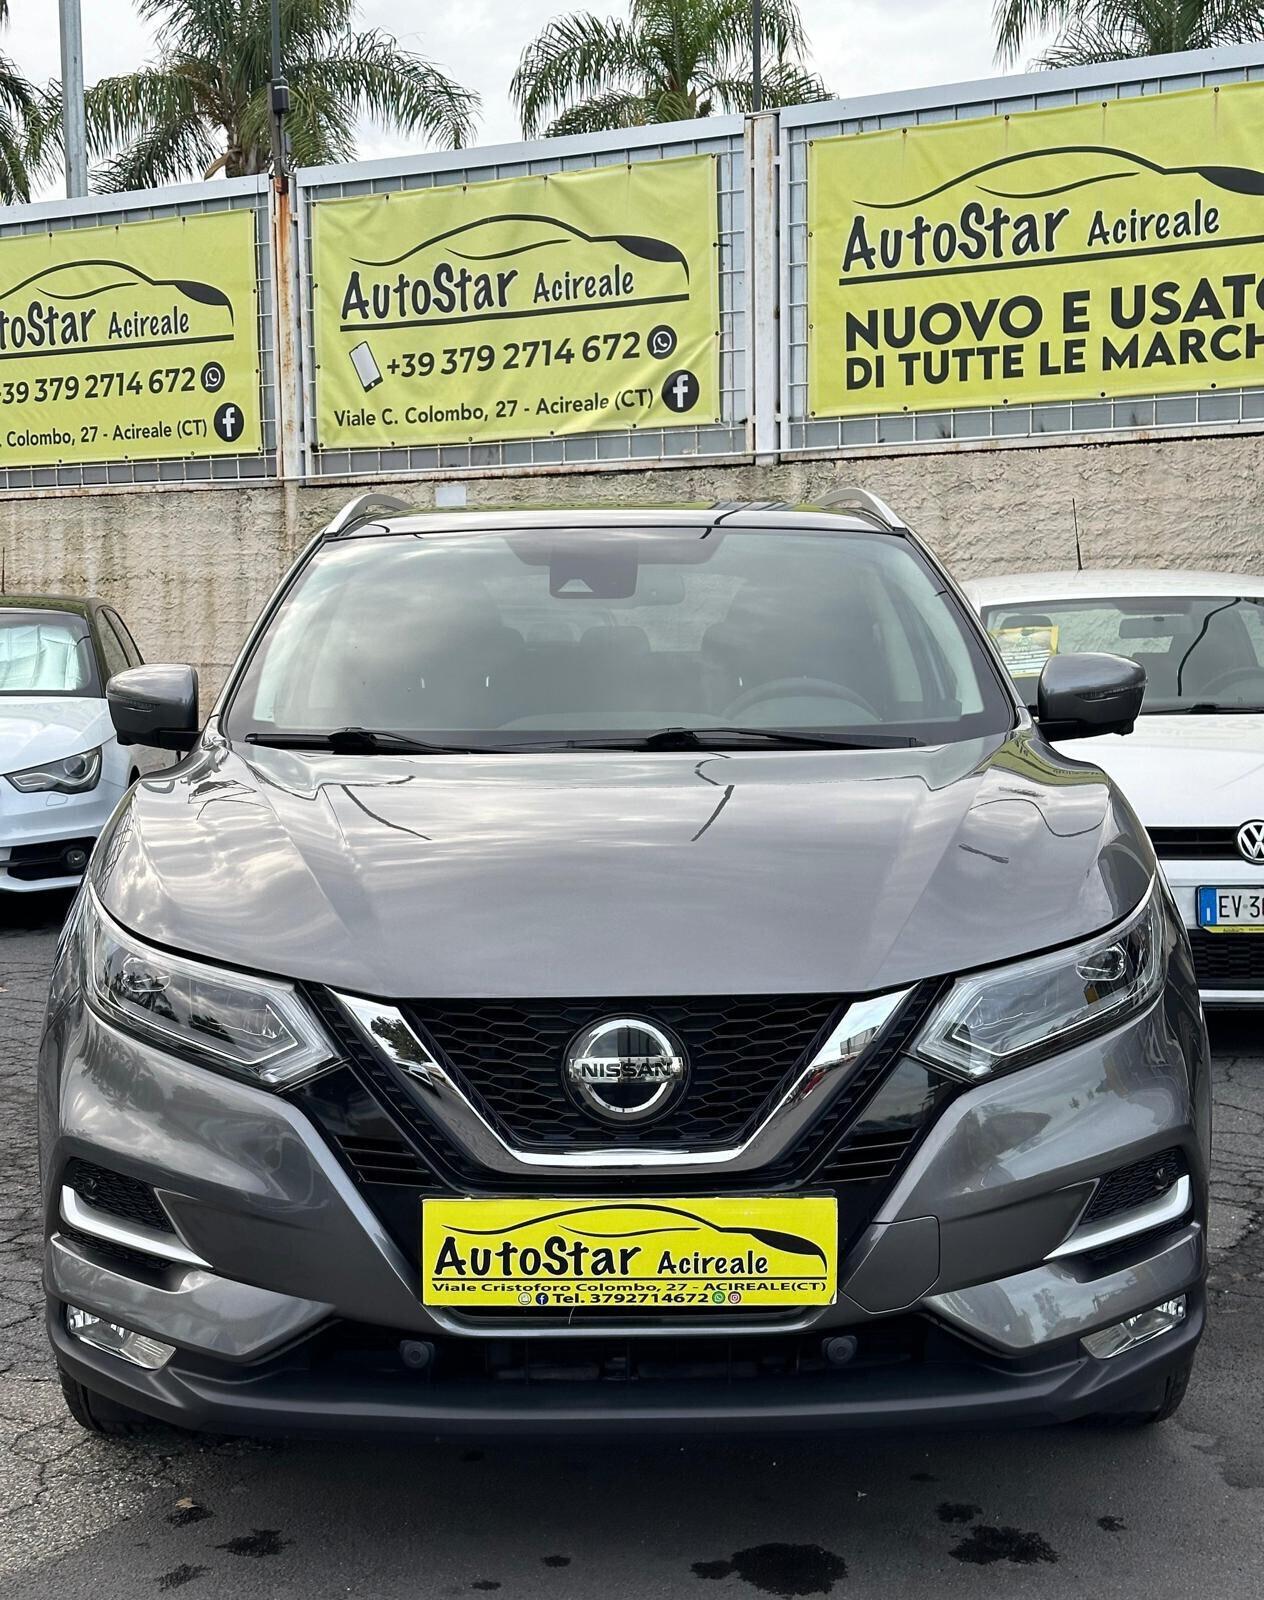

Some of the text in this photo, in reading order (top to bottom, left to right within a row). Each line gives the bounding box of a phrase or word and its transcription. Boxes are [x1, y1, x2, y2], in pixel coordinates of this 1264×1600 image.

[843, 199, 1220, 272] AutoStar Acireale
[341, 262, 634, 320] AutoStar Acireale
[108, 306, 189, 339] Acireale
[846, 273, 1264, 352] NUOVO E USAT
[387, 332, 640, 377] +39 379 2714 672
[847, 355, 884, 390] DI
[899, 345, 1024, 386] TUTTE
[1040, 339, 1085, 376] LE
[0, 367, 195, 404] 39 379 2714 672
[334, 409, 376, 426] Viale
[382, 409, 398, 425] C.
[405, 403, 488, 423] Colombo,
[496, 400, 517, 418] 27
[536, 393, 608, 415] Acireale
[615, 388, 654, 409] (CT)
[7, 428, 75, 447] Colombo,
[81, 426, 98, 442] 27
[113, 421, 172, 440] Acireale
[177, 419, 207, 438] (CT)
[1219, 895, 1242, 918] EV
[1250, 895, 1264, 918] 3
[582, 1062, 671, 1078] NISSAN
[434, 1236, 767, 1276] AutoStar Acireale
[482, 1283, 571, 1292] Cristoforo
[576, 1283, 661, 1292] Colombo,
[704, 1283, 826, 1292] ACIREALE(CT)
[552, 1293, 585, 1303] Tel.
[590, 1293, 708, 1303] 3792714672
